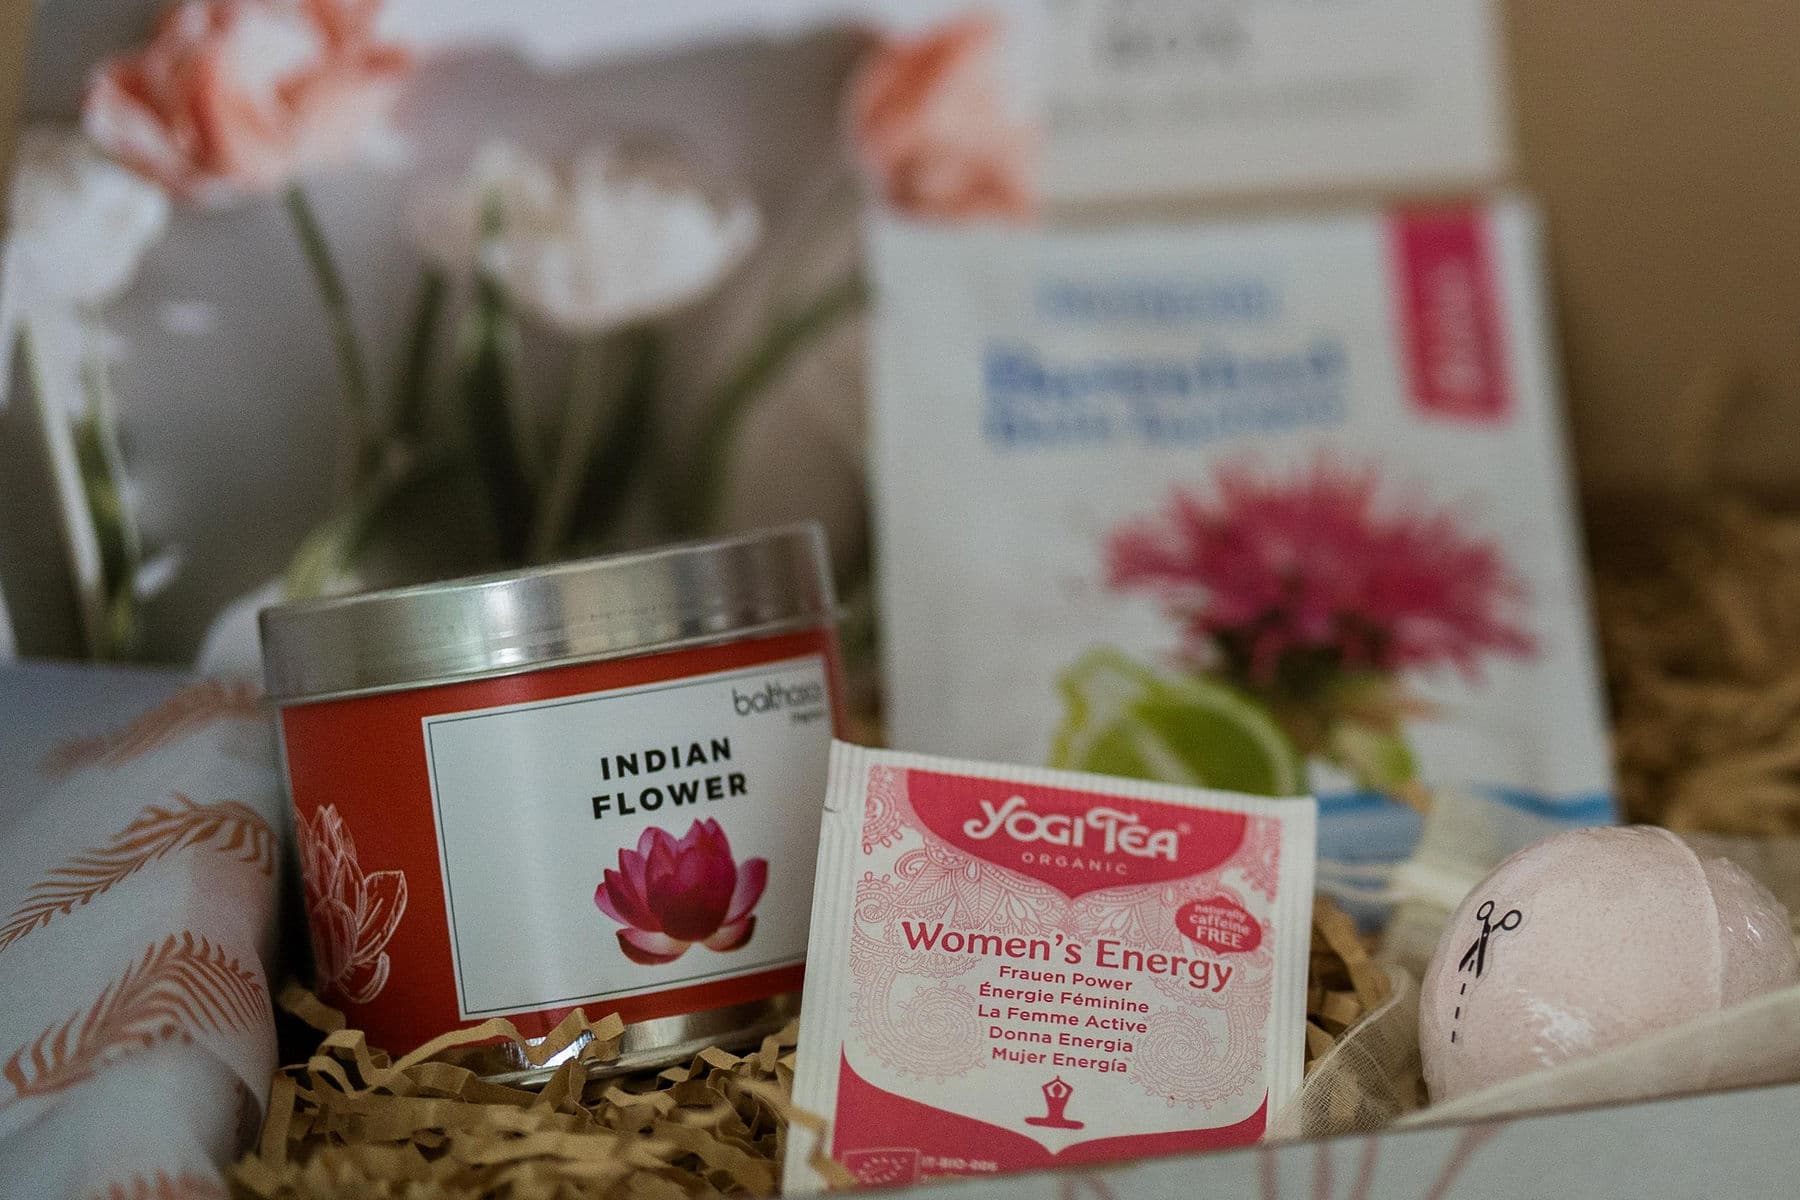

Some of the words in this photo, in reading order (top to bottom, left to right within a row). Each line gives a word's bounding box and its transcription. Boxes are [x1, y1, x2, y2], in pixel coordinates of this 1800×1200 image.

[600, 737, 732, 780] INDIAN
[591, 772, 748, 820] FLOWER
[963, 795, 1084, 847] YOGI
[1086, 806, 1178, 861] TEA
[1021, 851, 1128, 875] ORGANIC
[1189, 913, 1250, 936] caffeine
[1196, 926, 1243, 949] FREE
[901, 921, 1082, 965] Women's
[1096, 939, 1233, 993] Energy
[999, 965, 1066, 984] Frauen
[1072, 973, 1133, 991] Power
[979, 981, 1055, 1004] Énergie
[1060, 991, 1150, 1014] Féminine
[978, 1004, 1001, 1019] La
[1007, 1007, 1079, 1026] Femme
[1085, 1015, 1148, 1034] Active
[989, 1026, 1052, 1045] Donna
[1058, 1032, 1134, 1053] Energia
[992, 1047, 1047, 1065] Mujer
[1053, 1053, 1128, 1073] Energía
